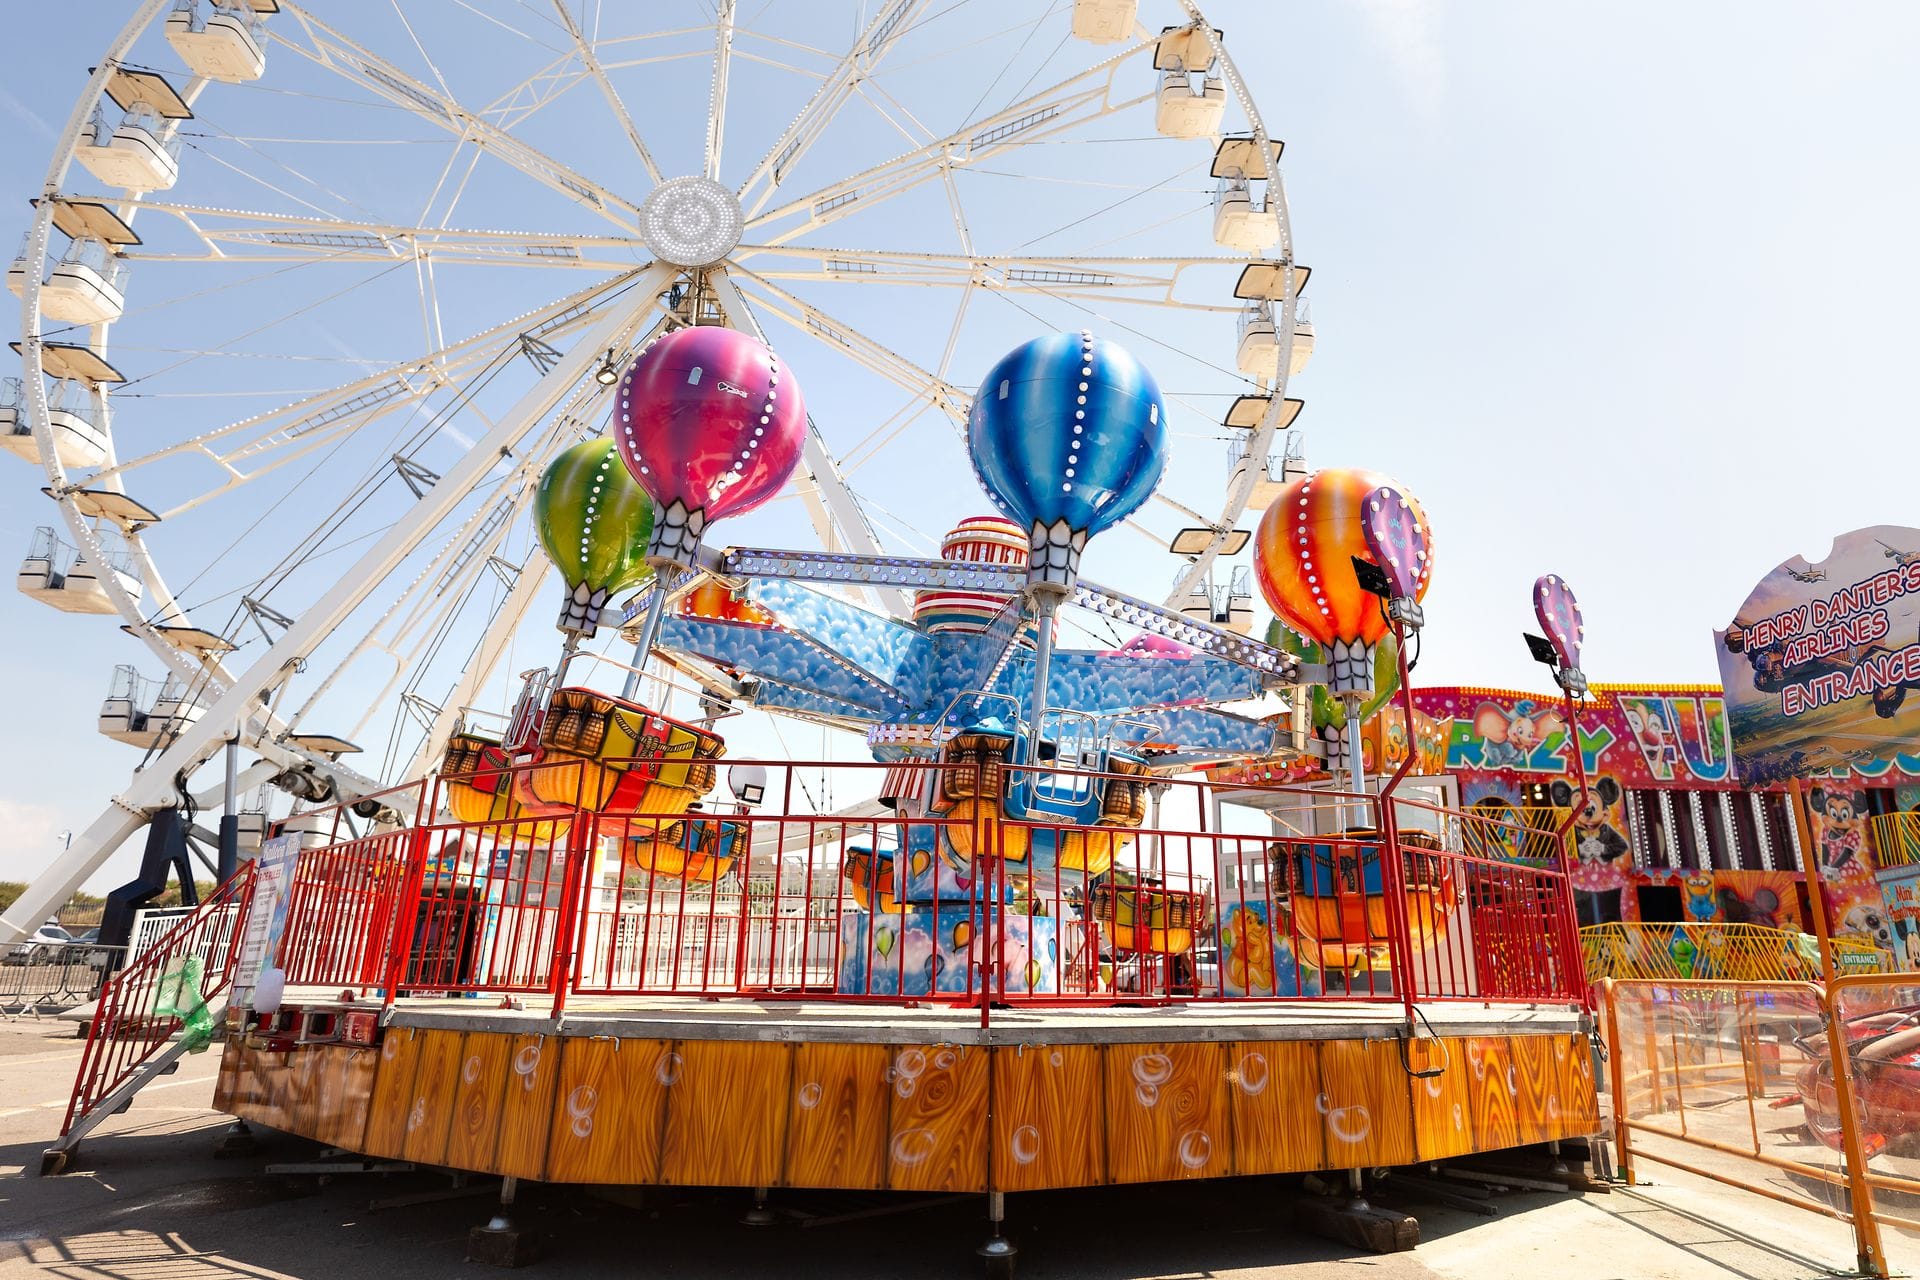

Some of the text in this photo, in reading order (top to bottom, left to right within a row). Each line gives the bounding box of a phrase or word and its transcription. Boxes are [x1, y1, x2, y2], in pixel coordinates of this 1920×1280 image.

[1744, 564, 1920, 652] HENRY DANTER'S
[1783, 612, 1888, 667] AIRLINES
[1783, 646, 1920, 716] ENTRANCE
[1843, 954, 1877, 964] ENTRANCE
